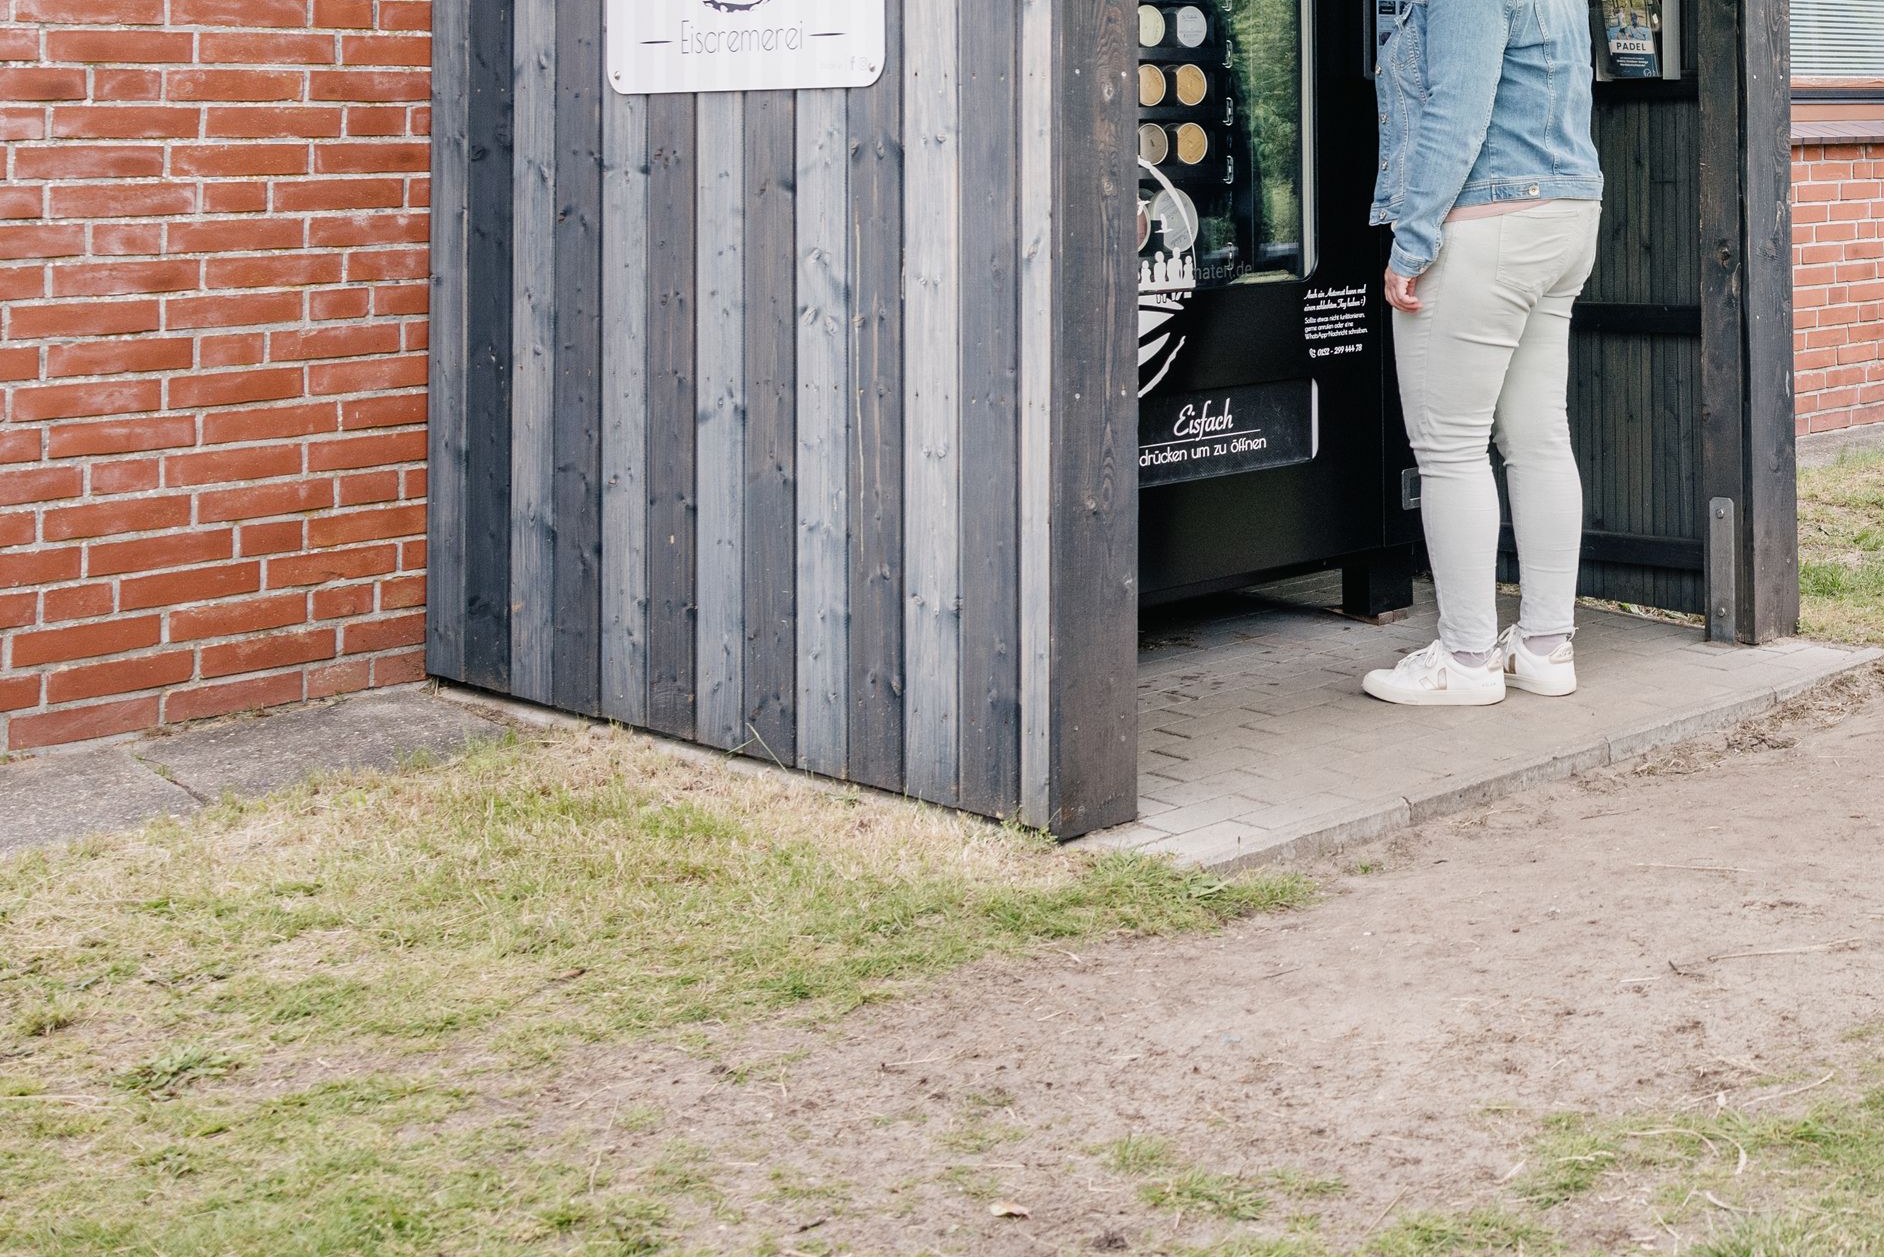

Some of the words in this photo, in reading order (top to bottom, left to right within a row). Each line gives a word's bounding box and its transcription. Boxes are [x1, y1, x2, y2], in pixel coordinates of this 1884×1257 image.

[681, 19, 804, 54] Eiscremerei
[1616, 42, 1647, 51] PADEL
[1173, 397, 1234, 441] Eisfach
[1139, 446, 1188, 467] drücken
[1191, 446, 1210, 459] um
[1213, 443, 1227, 456] zu
[1230, 437, 1267, 453] öffnen
